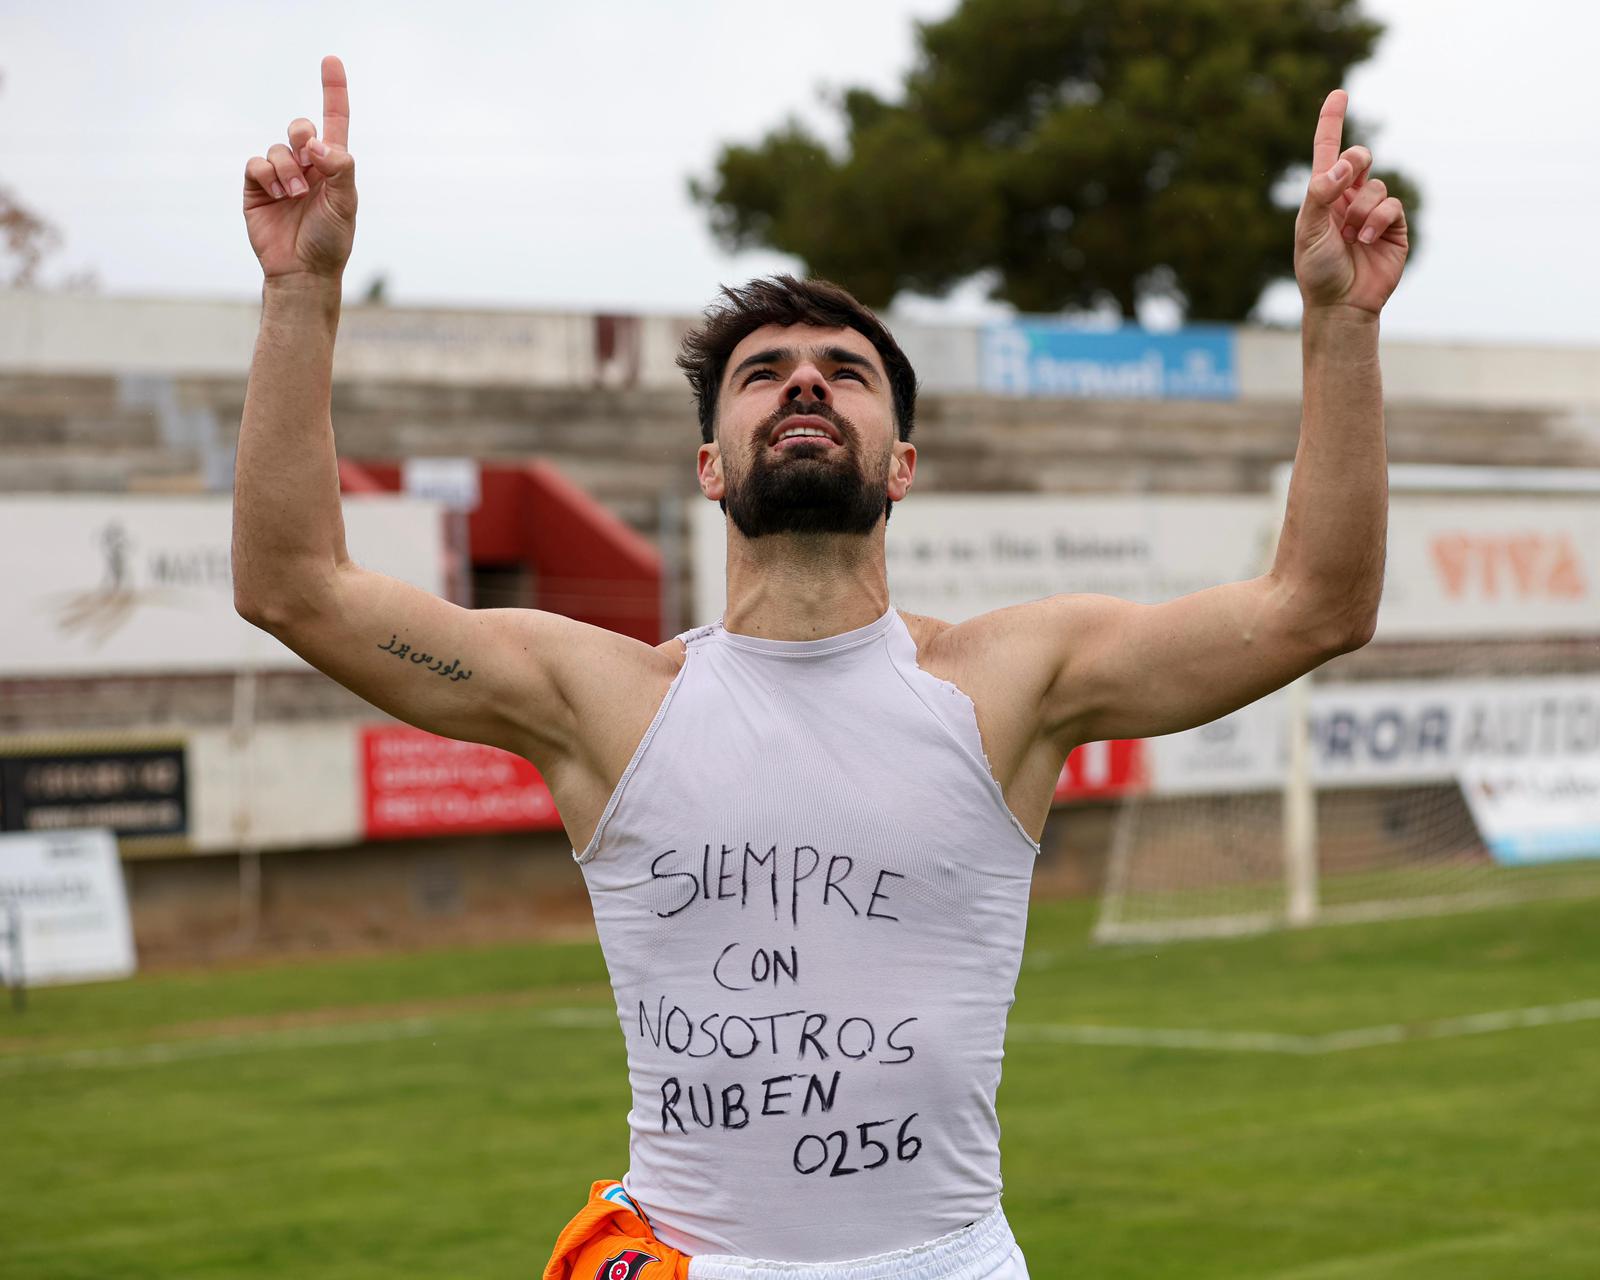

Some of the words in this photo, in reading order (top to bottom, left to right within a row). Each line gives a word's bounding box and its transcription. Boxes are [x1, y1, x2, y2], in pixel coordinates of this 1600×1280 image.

[1428, 528, 1590, 602] VIVA
[650, 842, 904, 929] SIEMPRE
[713, 942, 799, 991] CON
[639, 995, 919, 1064] NOSOTROS
[660, 1071, 841, 1135] RUBEN
[793, 1113, 923, 1178] 0256
